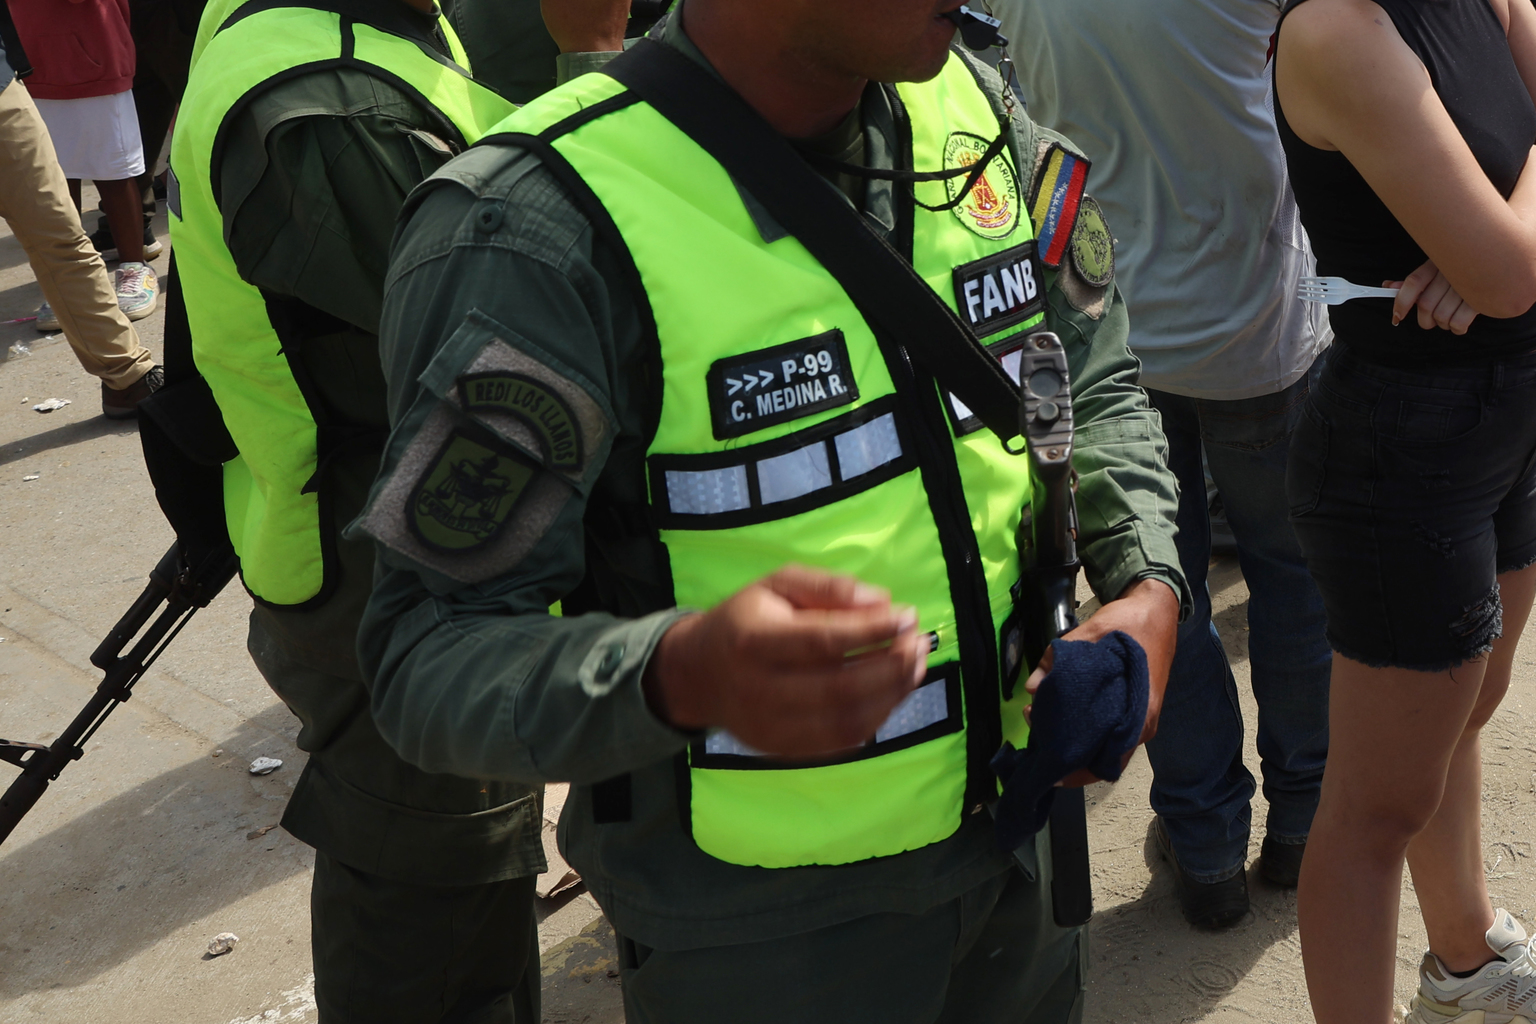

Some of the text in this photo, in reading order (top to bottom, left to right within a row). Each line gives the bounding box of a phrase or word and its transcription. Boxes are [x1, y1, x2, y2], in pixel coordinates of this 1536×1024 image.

[963, 258, 1038, 323] FANB
[781, 350, 833, 383] P-99
[475, 381, 576, 462] REDI LOS LLANOS
[731, 374, 848, 422] C. MEDINA R.
